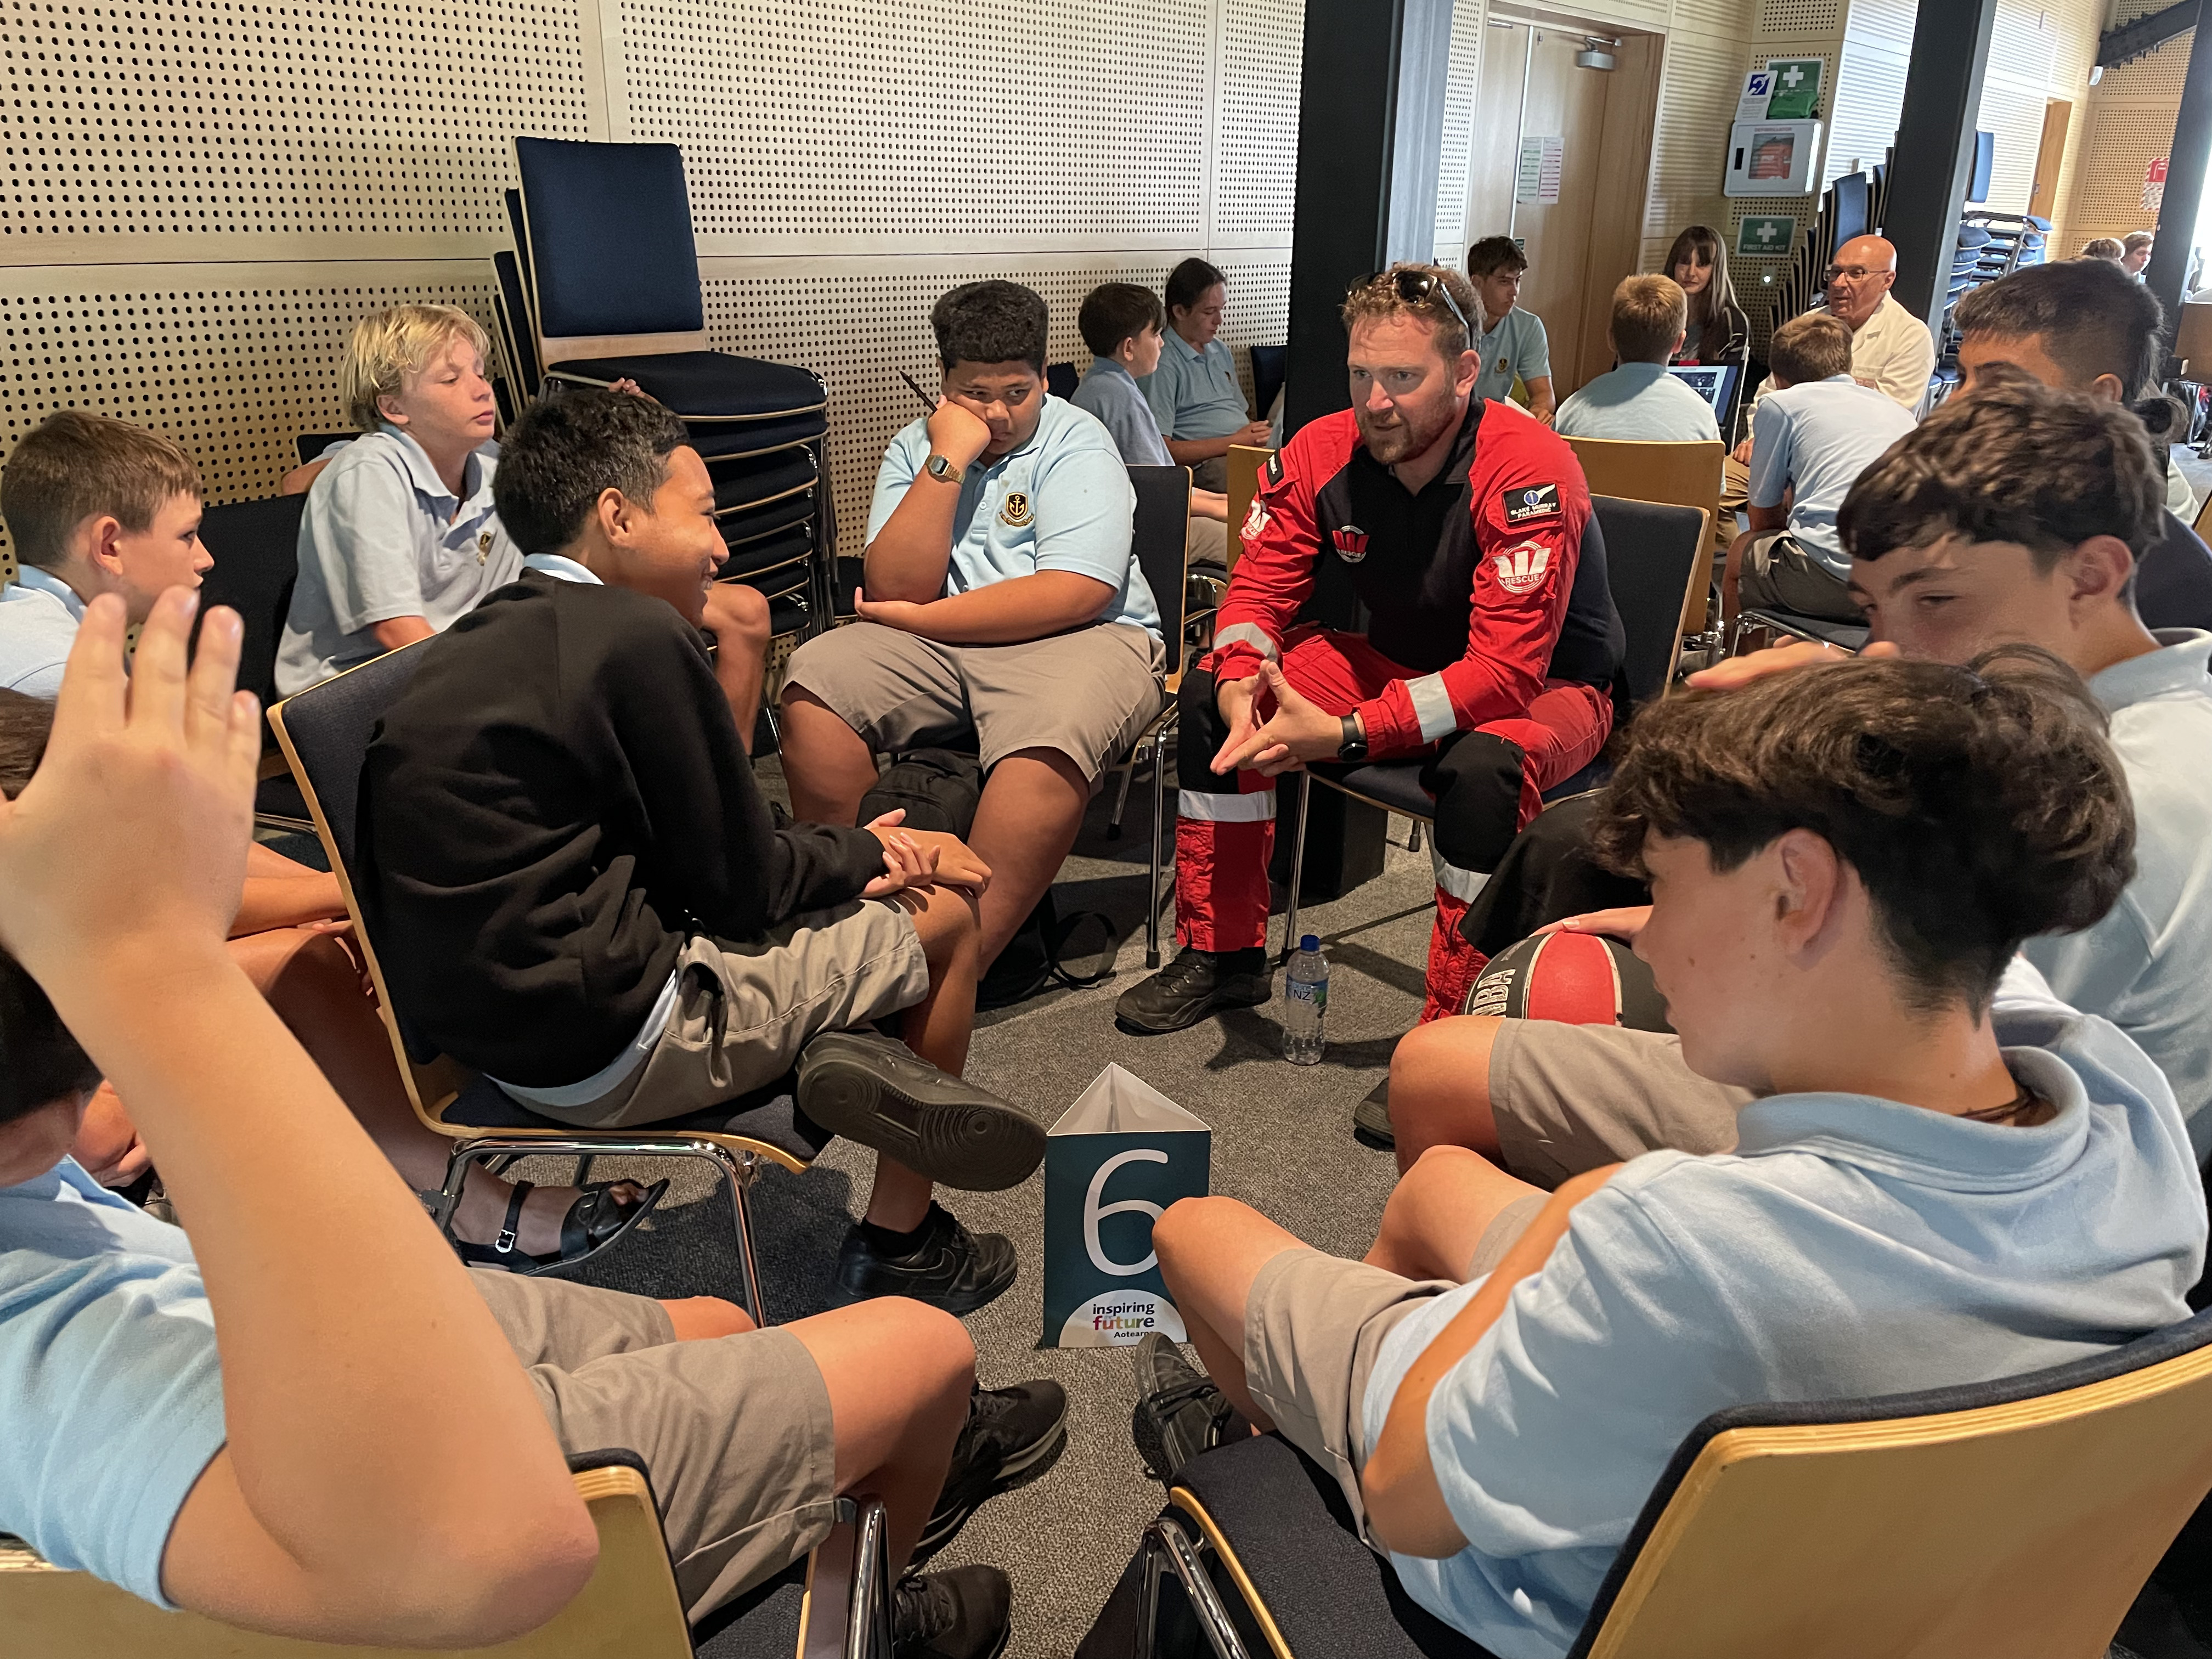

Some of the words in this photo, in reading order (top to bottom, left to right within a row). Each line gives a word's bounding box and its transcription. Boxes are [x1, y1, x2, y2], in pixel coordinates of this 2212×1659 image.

[1517, 507, 1551, 518] PARAMEDIC
[1505, 574, 1540, 585] RESCUE
[1294, 989, 1311, 1000] NZ
[1084, 1149, 1169, 1276] 6
[1093, 1302, 1155, 1316] inspiring
[1092, 1316, 1155, 1330] future
